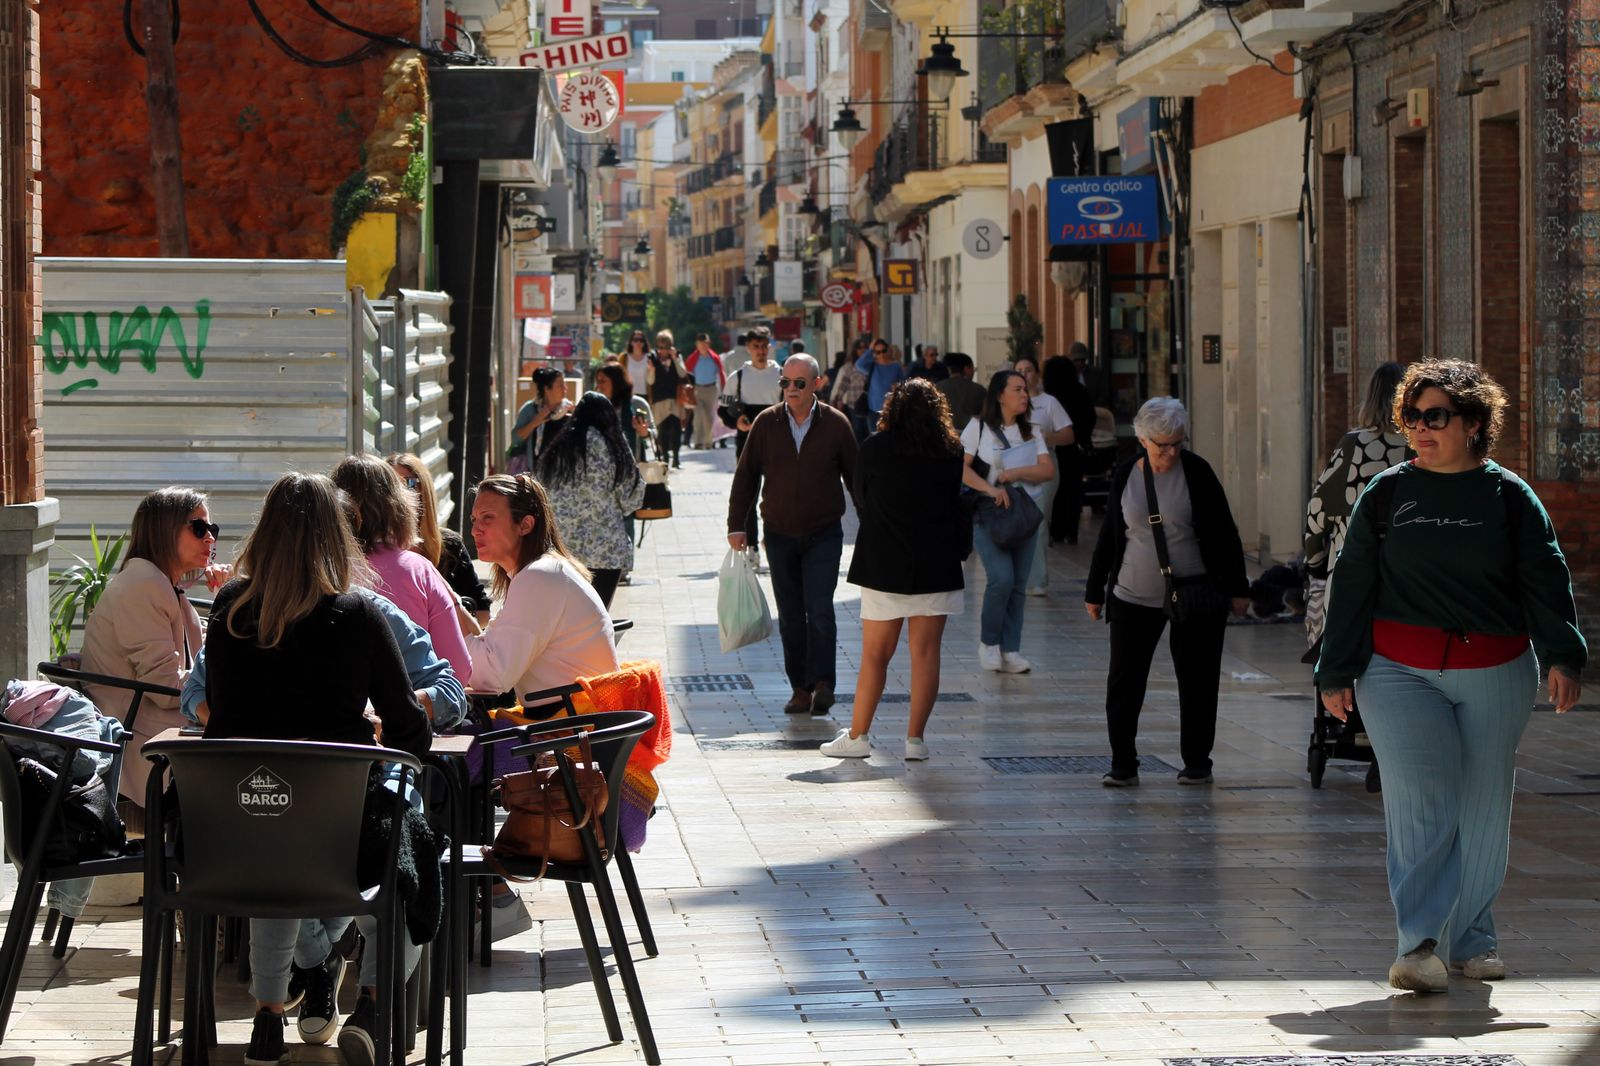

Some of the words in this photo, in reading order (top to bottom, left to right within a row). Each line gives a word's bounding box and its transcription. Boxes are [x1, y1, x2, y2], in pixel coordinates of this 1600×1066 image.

[519, 36, 628, 69] CHINO
[1060, 181, 1100, 194] centro
[1103, 180, 1143, 195] óptico
[241, 792, 289, 806] BARCO
